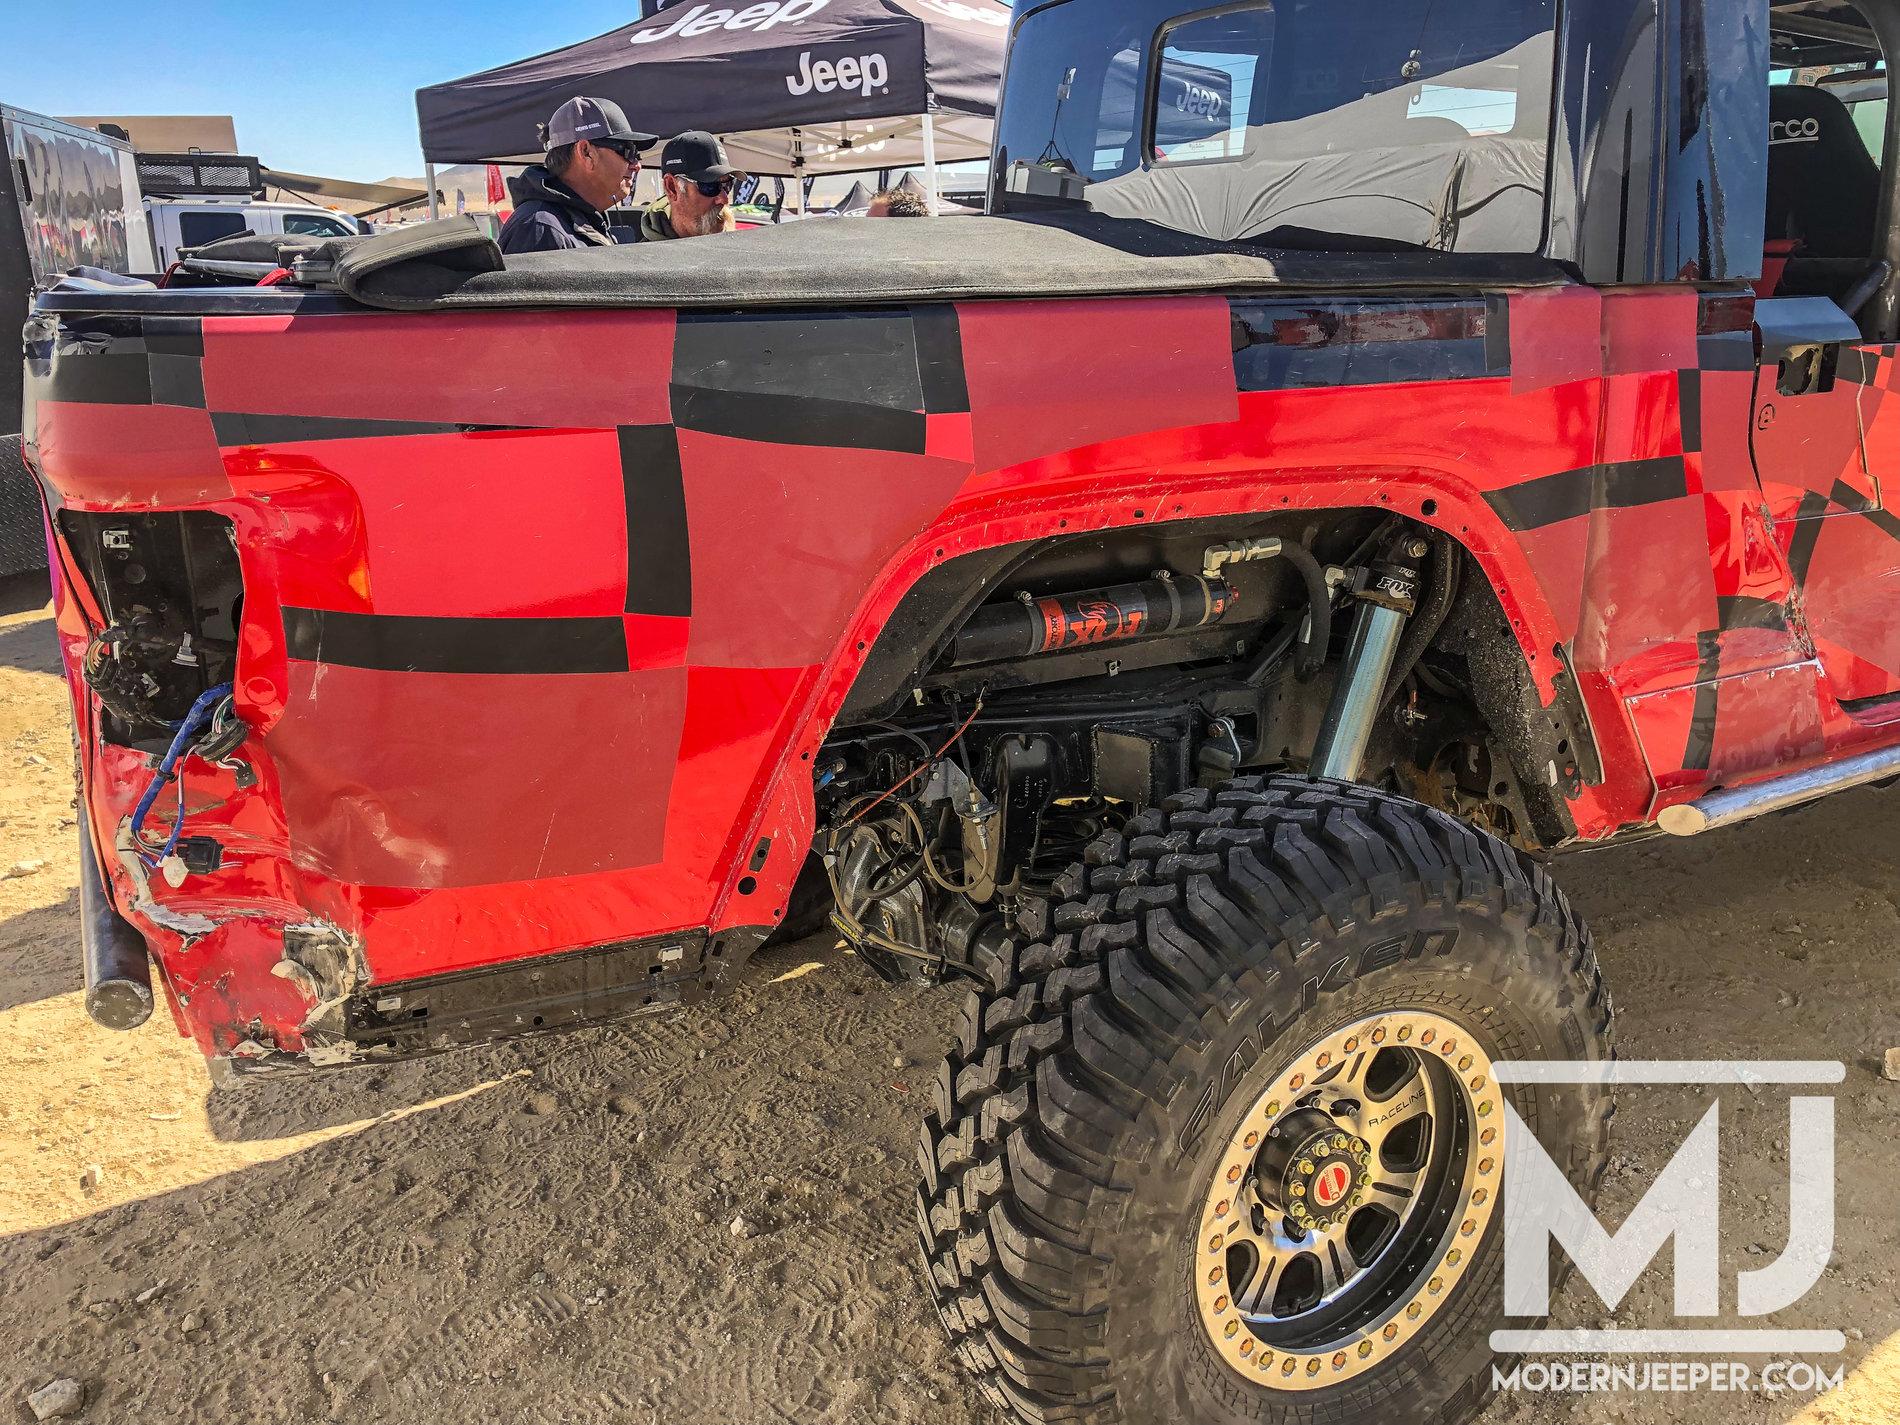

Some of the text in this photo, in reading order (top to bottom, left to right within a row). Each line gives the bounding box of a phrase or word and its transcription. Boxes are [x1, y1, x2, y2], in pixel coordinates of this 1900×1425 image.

[630, 0, 830, 43] Jeep
[786, 52, 888, 96] Jeep
[1176, 80, 1222, 122] Jeep
[1376, 576, 1415, 599] FOX
[1175, 928, 1460, 1171] FALKEN
[1368, 1088, 1426, 1127] RACELINE
